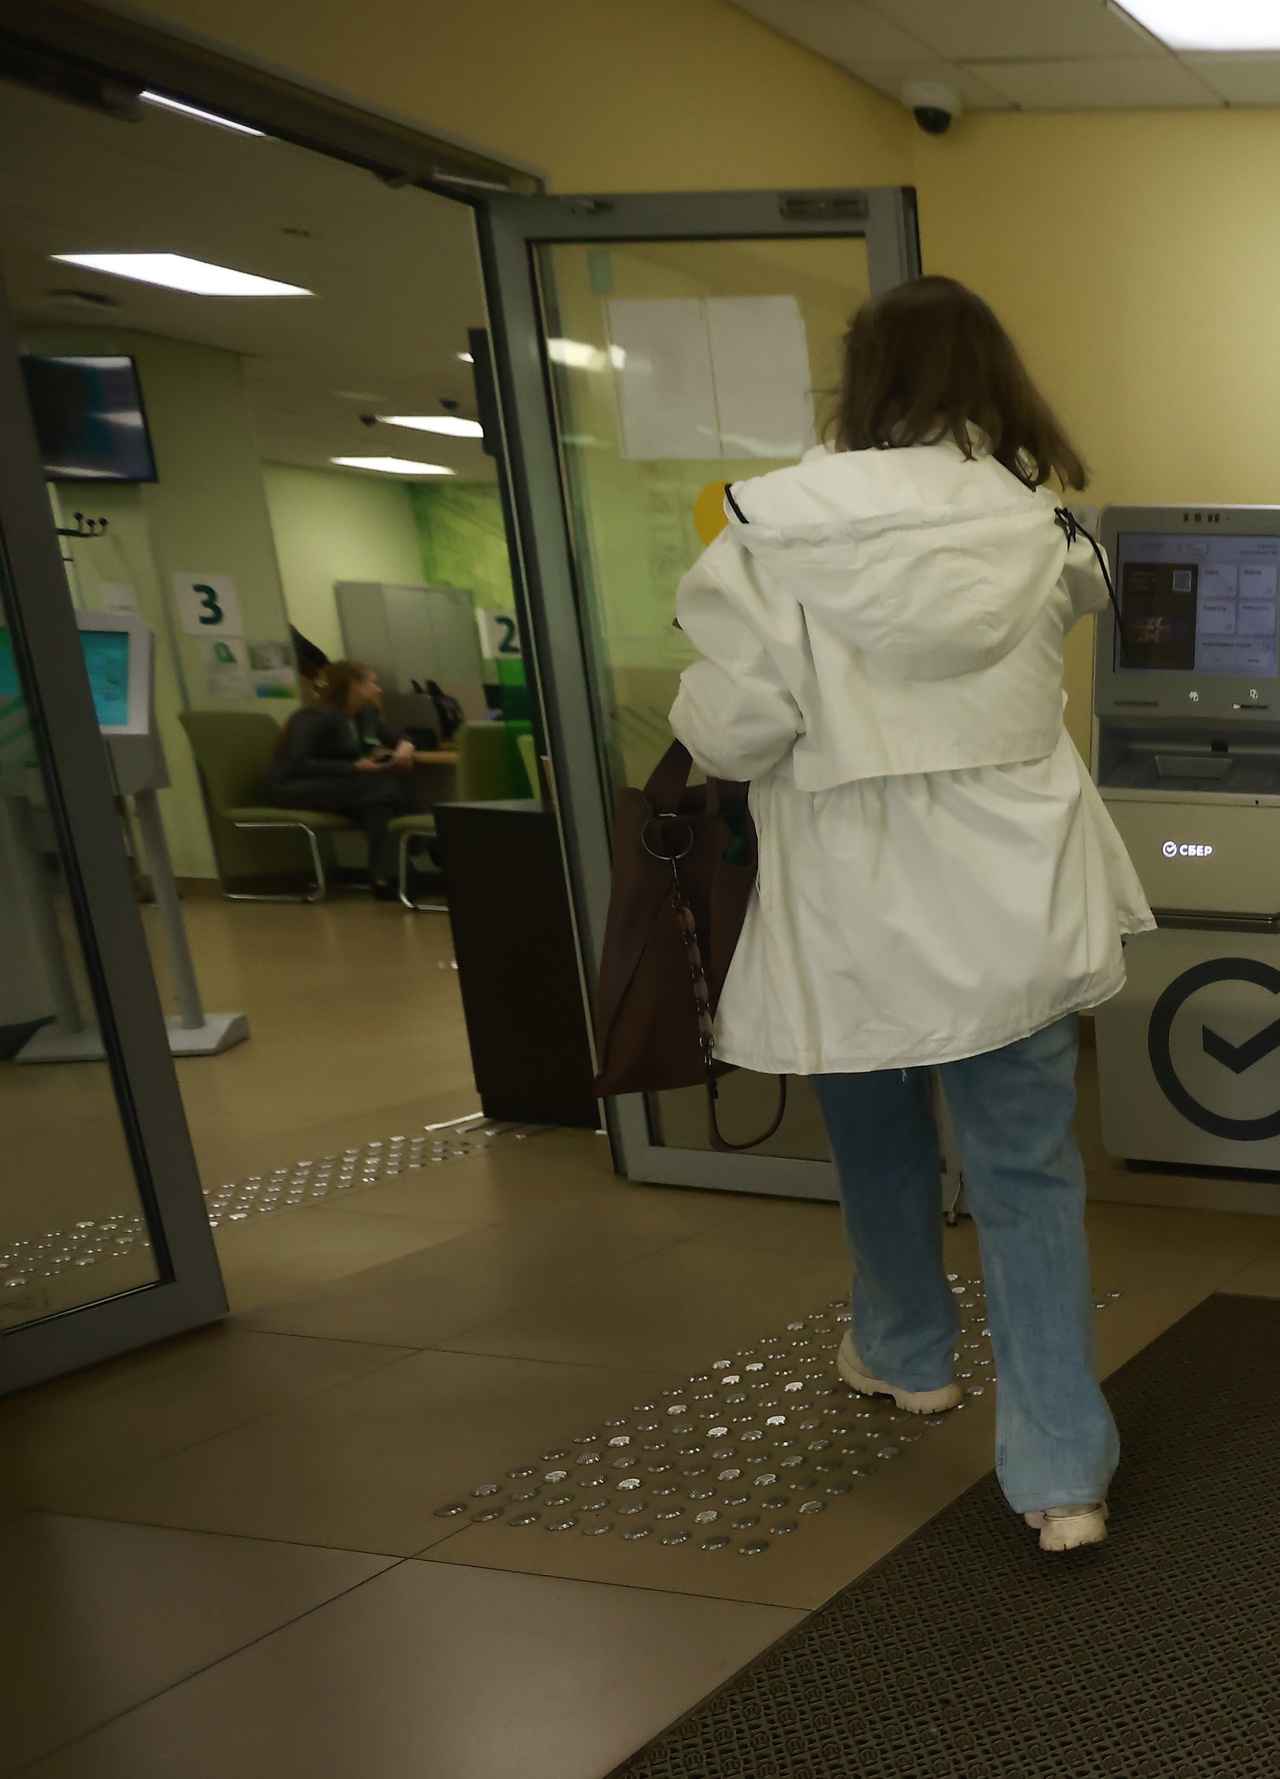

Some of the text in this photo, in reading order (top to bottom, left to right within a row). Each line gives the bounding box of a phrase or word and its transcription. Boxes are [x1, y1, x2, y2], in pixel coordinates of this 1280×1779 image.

[192, 584, 224, 625] 3
[495, 616, 519, 653] 2
[1179, 844, 1213, 857] СБЕР
